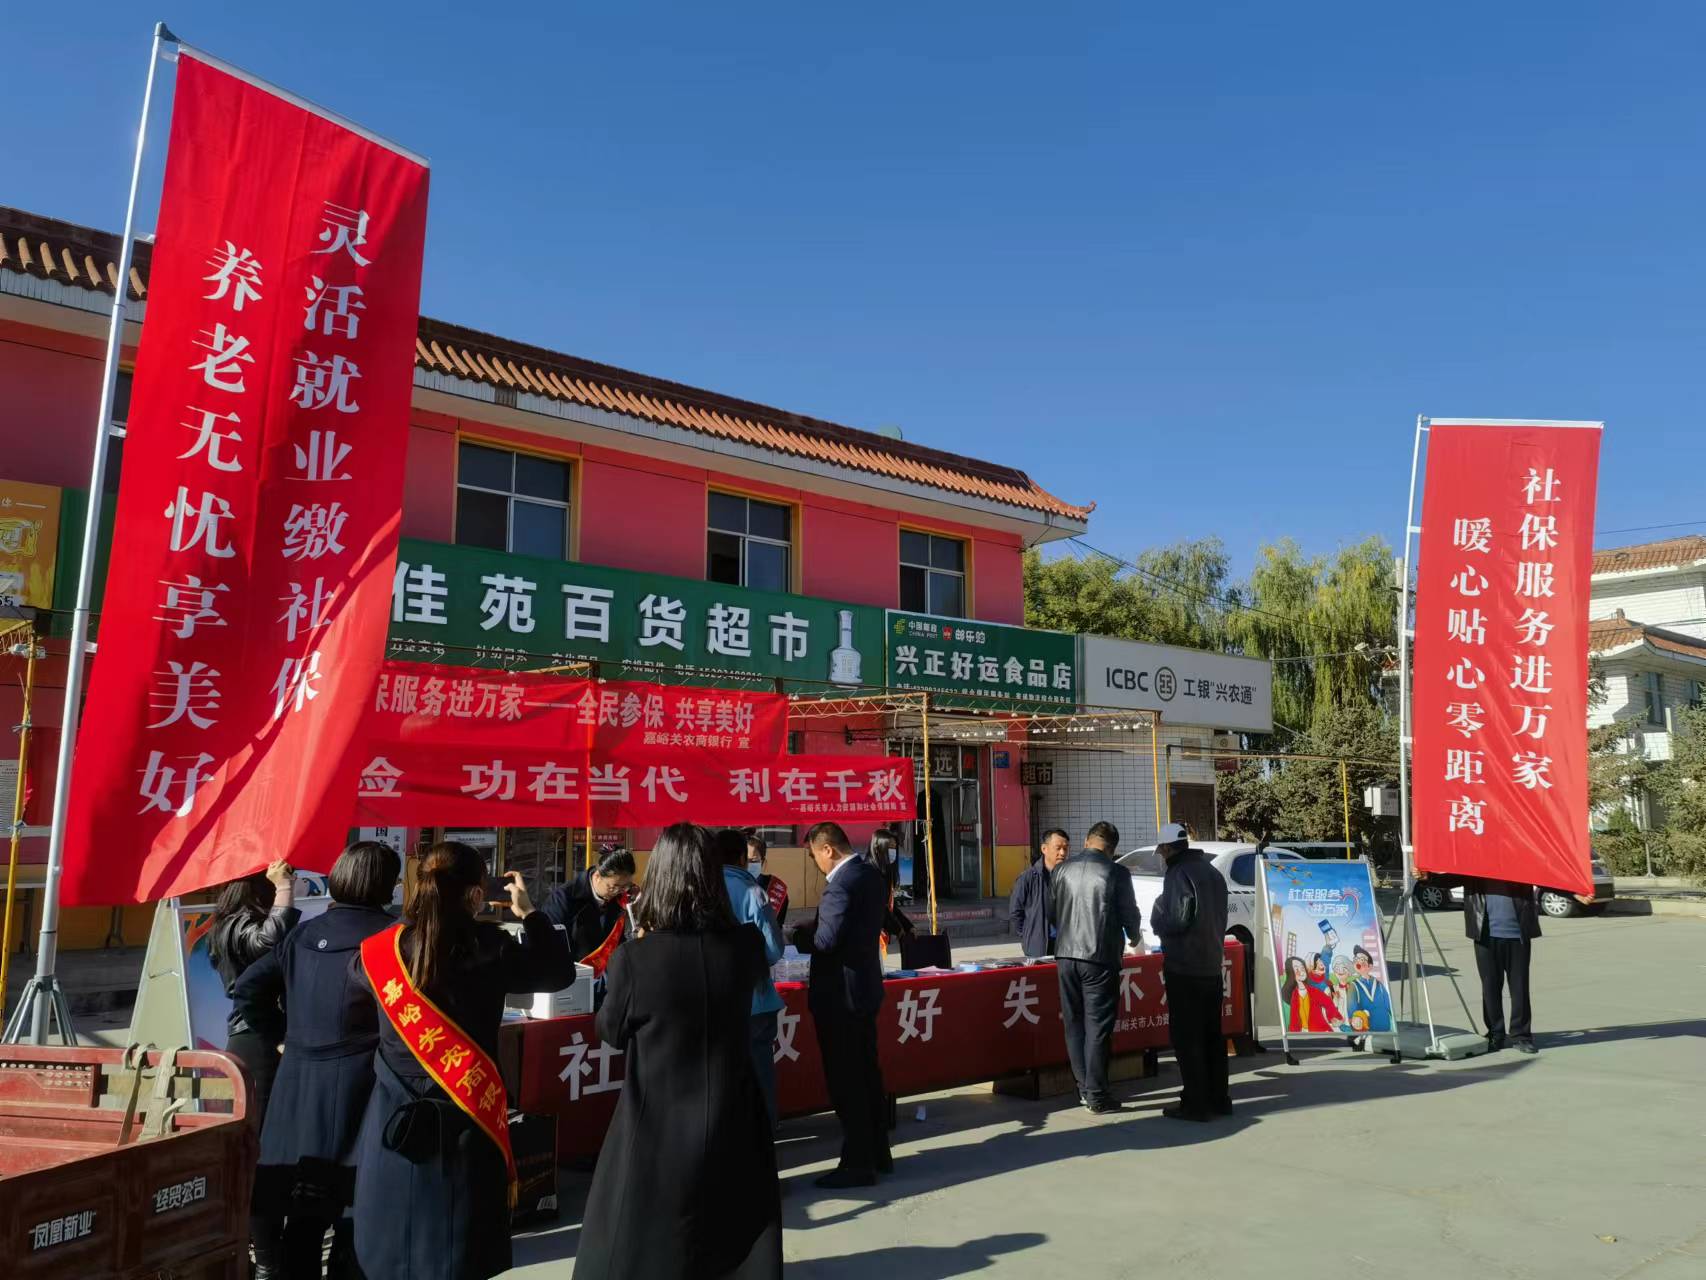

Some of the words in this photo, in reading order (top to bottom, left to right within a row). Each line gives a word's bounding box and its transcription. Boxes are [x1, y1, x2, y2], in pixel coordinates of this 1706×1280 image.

[271, 200, 373, 721] 灵活就业缴社保
[137, 239, 264, 818] 养老无忧享美好
[392, 560, 810, 662] 佳苑百货超市
[1509, 468, 1562, 791] 社保服务进万家
[895, 645, 1072, 690] 兴正好运食品店
[1106, 667, 1148, 692] ICBC
[1445, 517, 1493, 836] 暖心贴心零距离
[675, 697, 755, 735] 共享美好
[643, 731, 733, 749] 嘉峪关农商银行
[461, 760, 689, 803] 功在当代
[728, 767, 905, 803] 利在千秋
[1022, 763, 1051, 784] 超市
[154, 1175, 207, 1213] 经贸公司
[31, 1210, 95, 1250] 凤凰新业
